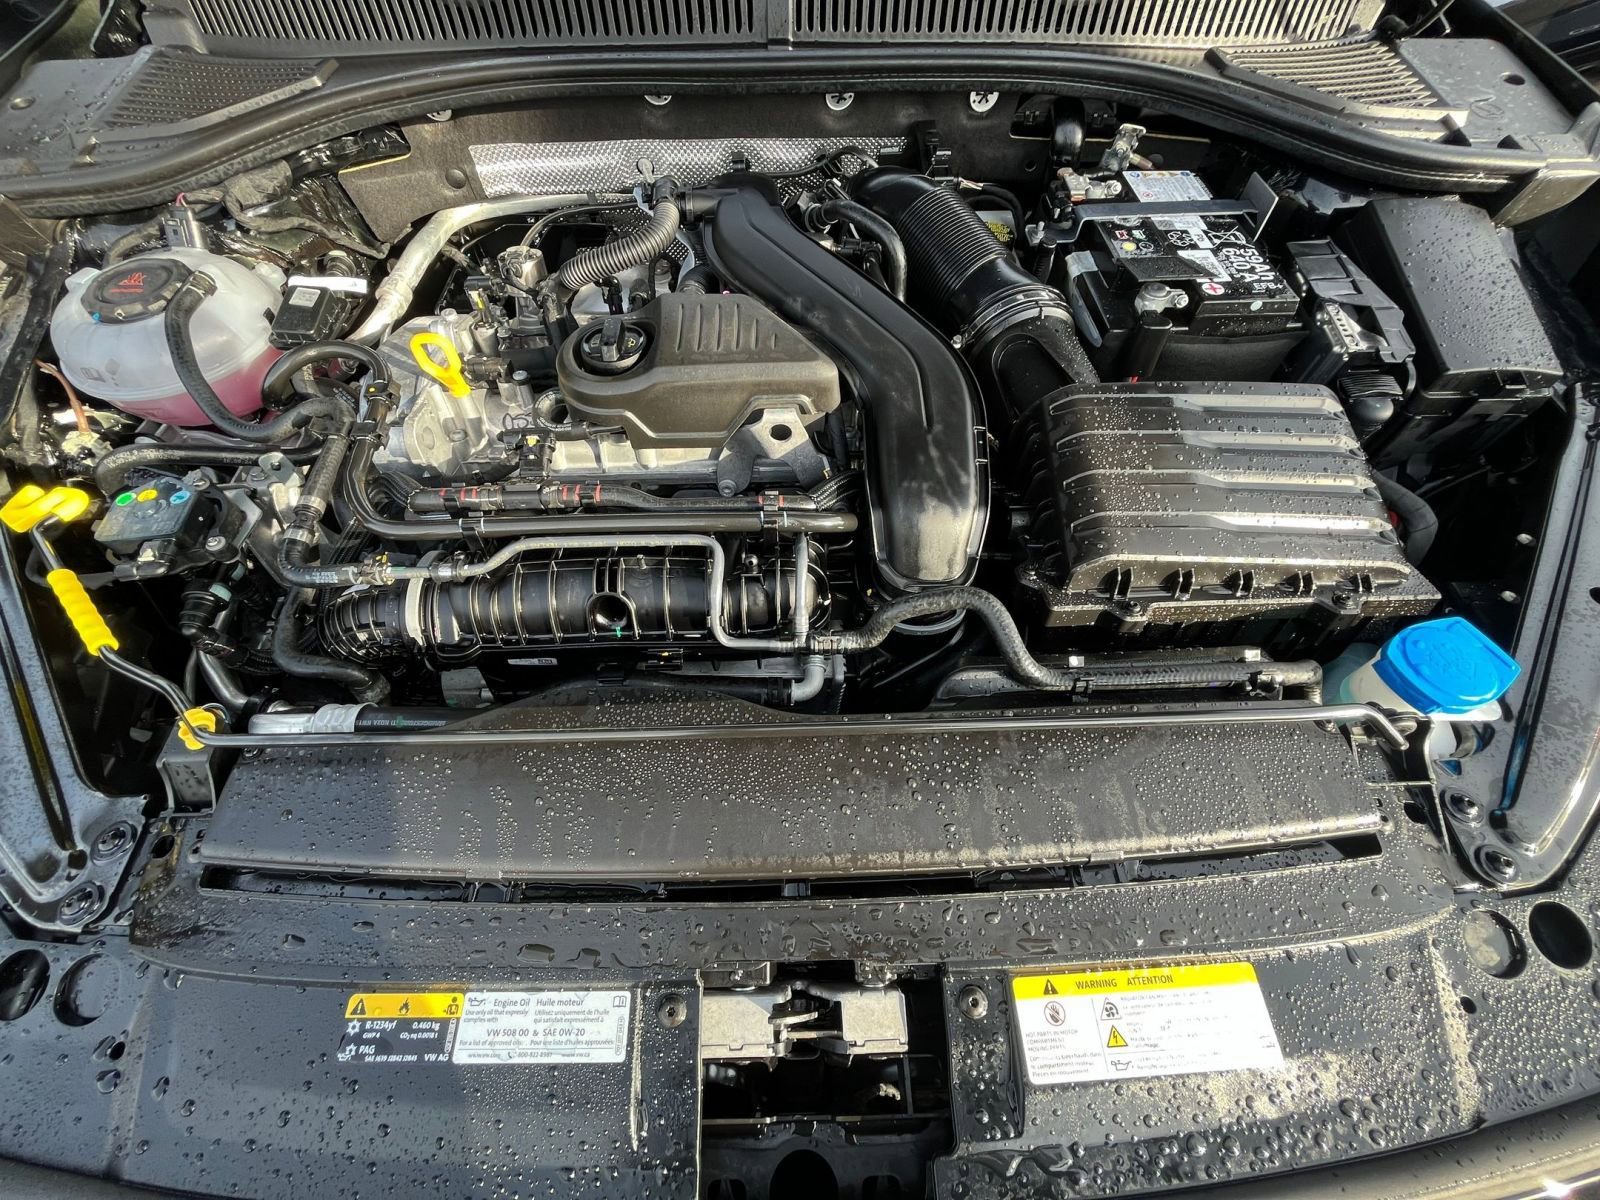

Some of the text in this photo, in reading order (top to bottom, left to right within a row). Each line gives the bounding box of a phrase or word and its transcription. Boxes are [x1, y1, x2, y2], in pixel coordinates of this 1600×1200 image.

[1222, 248, 1252, 270] 640
[1239, 272, 1260, 282] A
[1240, 248, 1276, 281] 59Ah
[1076, 974, 1174, 990] WARNING ATTENTION
[494, 998, 531, 1008] Engine Oil
[536, 998, 555, 1006] Huile
[365, 1020, 440, 1031] R-1234yf 0.460 kg
[487, 1028, 501, 1036] VW
[502, 1028, 516, 1036] 508
[518, 1028, 529, 1036] 00
[543, 1028, 557, 1036] SAE
[558, 1028, 585, 1036] 0W-20
[358, 1045, 375, 1054] PAG
